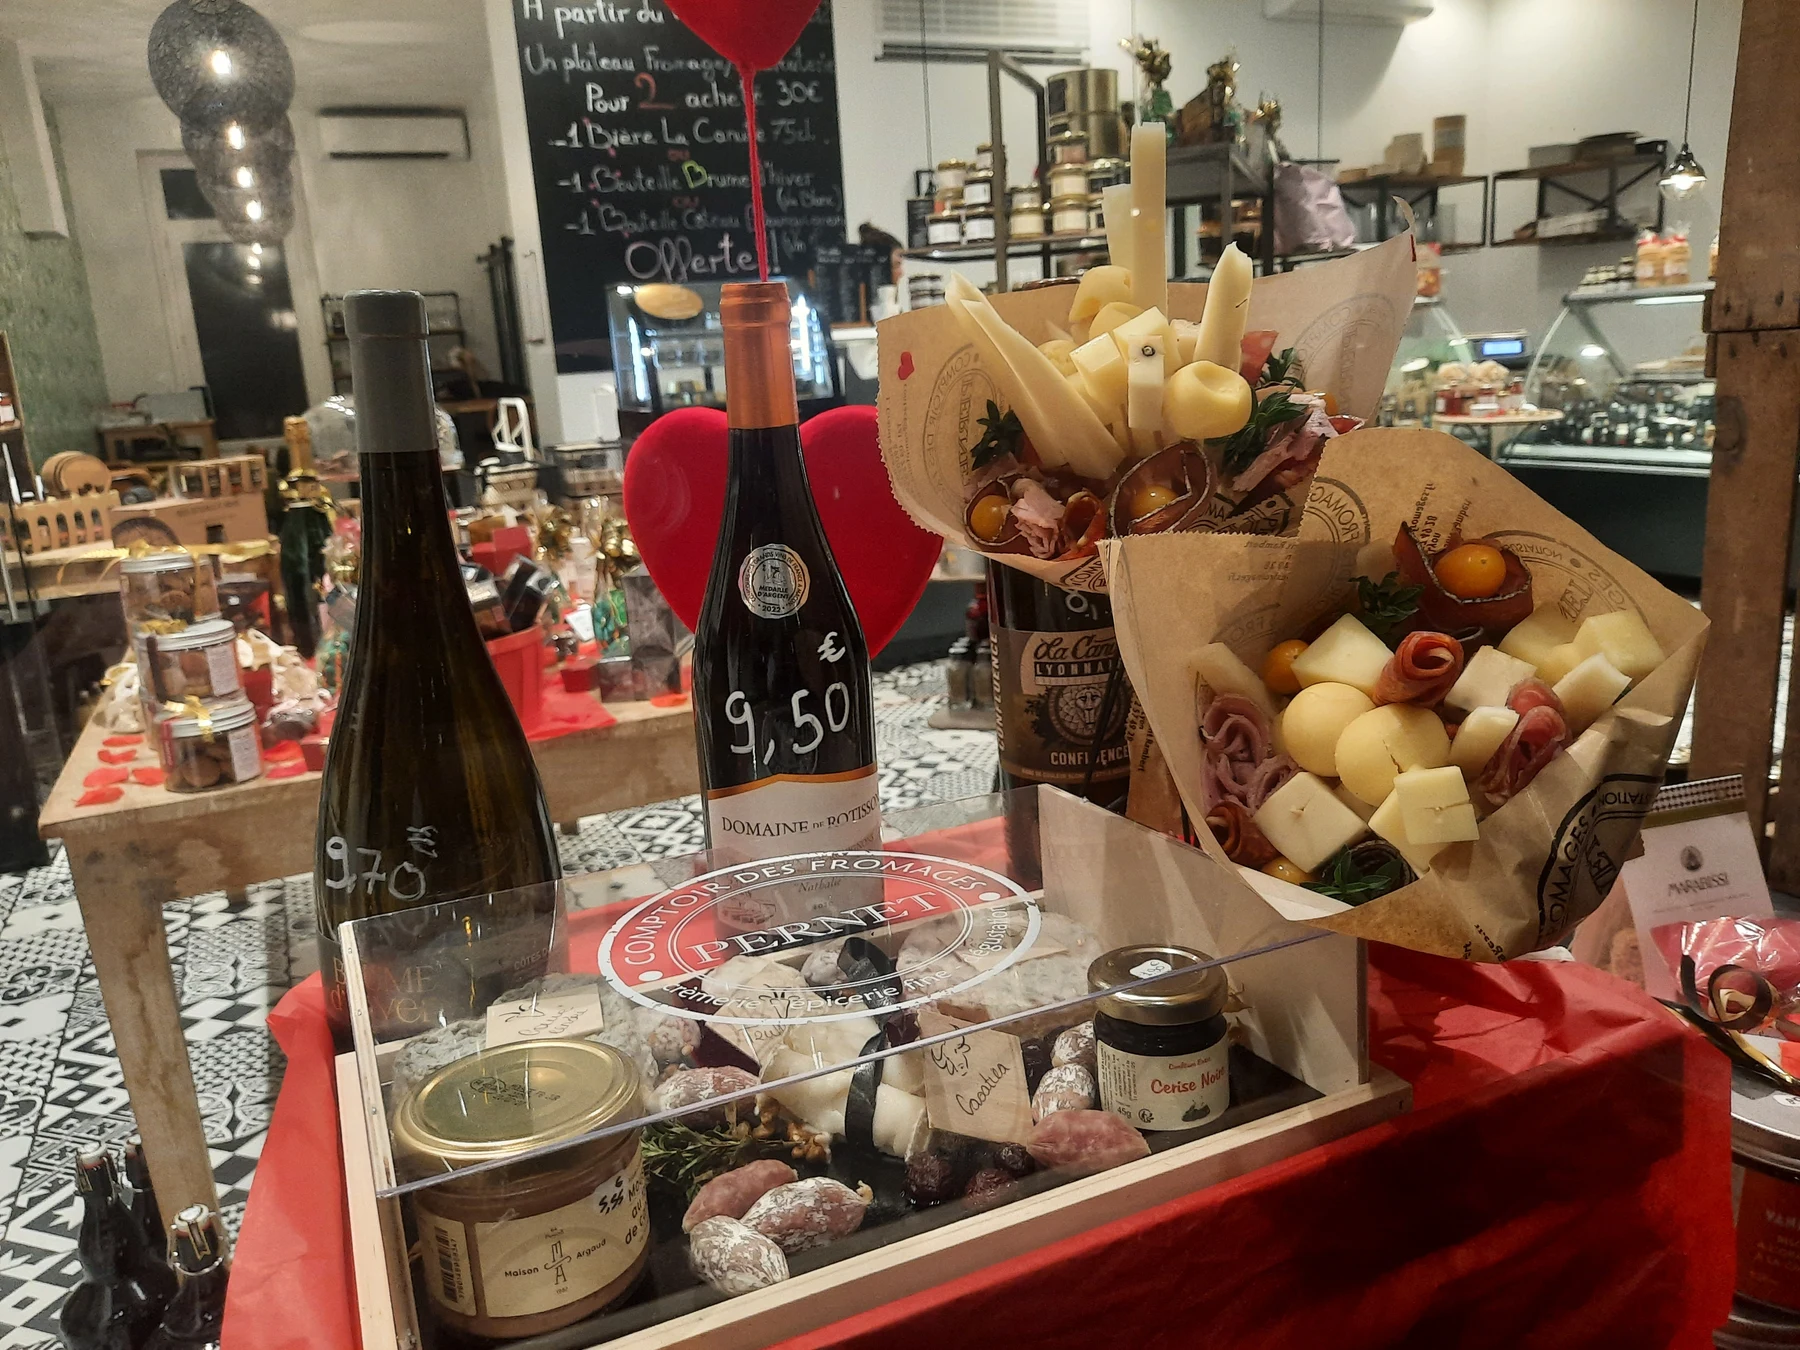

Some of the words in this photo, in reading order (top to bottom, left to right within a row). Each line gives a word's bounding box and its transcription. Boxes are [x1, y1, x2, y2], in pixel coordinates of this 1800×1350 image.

[553, 0, 631, 39] partir
[635, 0, 664, 24] du
[525, 43, 557, 75] Un
[563, 42, 636, 83] plateau
[586, 82, 629, 113] Pour
[635, 72, 675, 109] 2
[777, 79, 823, 107] 30€
[583, 120, 658, 149] Bière
[661, 116, 689, 146] La
[625, 231, 763, 282] Offerte
[817, 631, 846, 663] €
[725, 682, 849, 766] 9,50
[721, 816, 809, 838] DOMAINE
[625, 878, 733, 966] COMPTOIR
[734, 862, 796, 884] DES
[811, 857, 987, 891] FROMAGES
[686, 890, 945, 965] PERNET
[903, 964, 952, 993] fine
[963, 904, 1009, 964] dégustation
[1150, 1077, 1197, 1094] Cerise
[1116, 1104, 1132, 1120] 45g
[625, 1225, 638, 1245] de
[504, 1265, 539, 1278] Maison
[576, 1238, 607, 1259] Argaud
